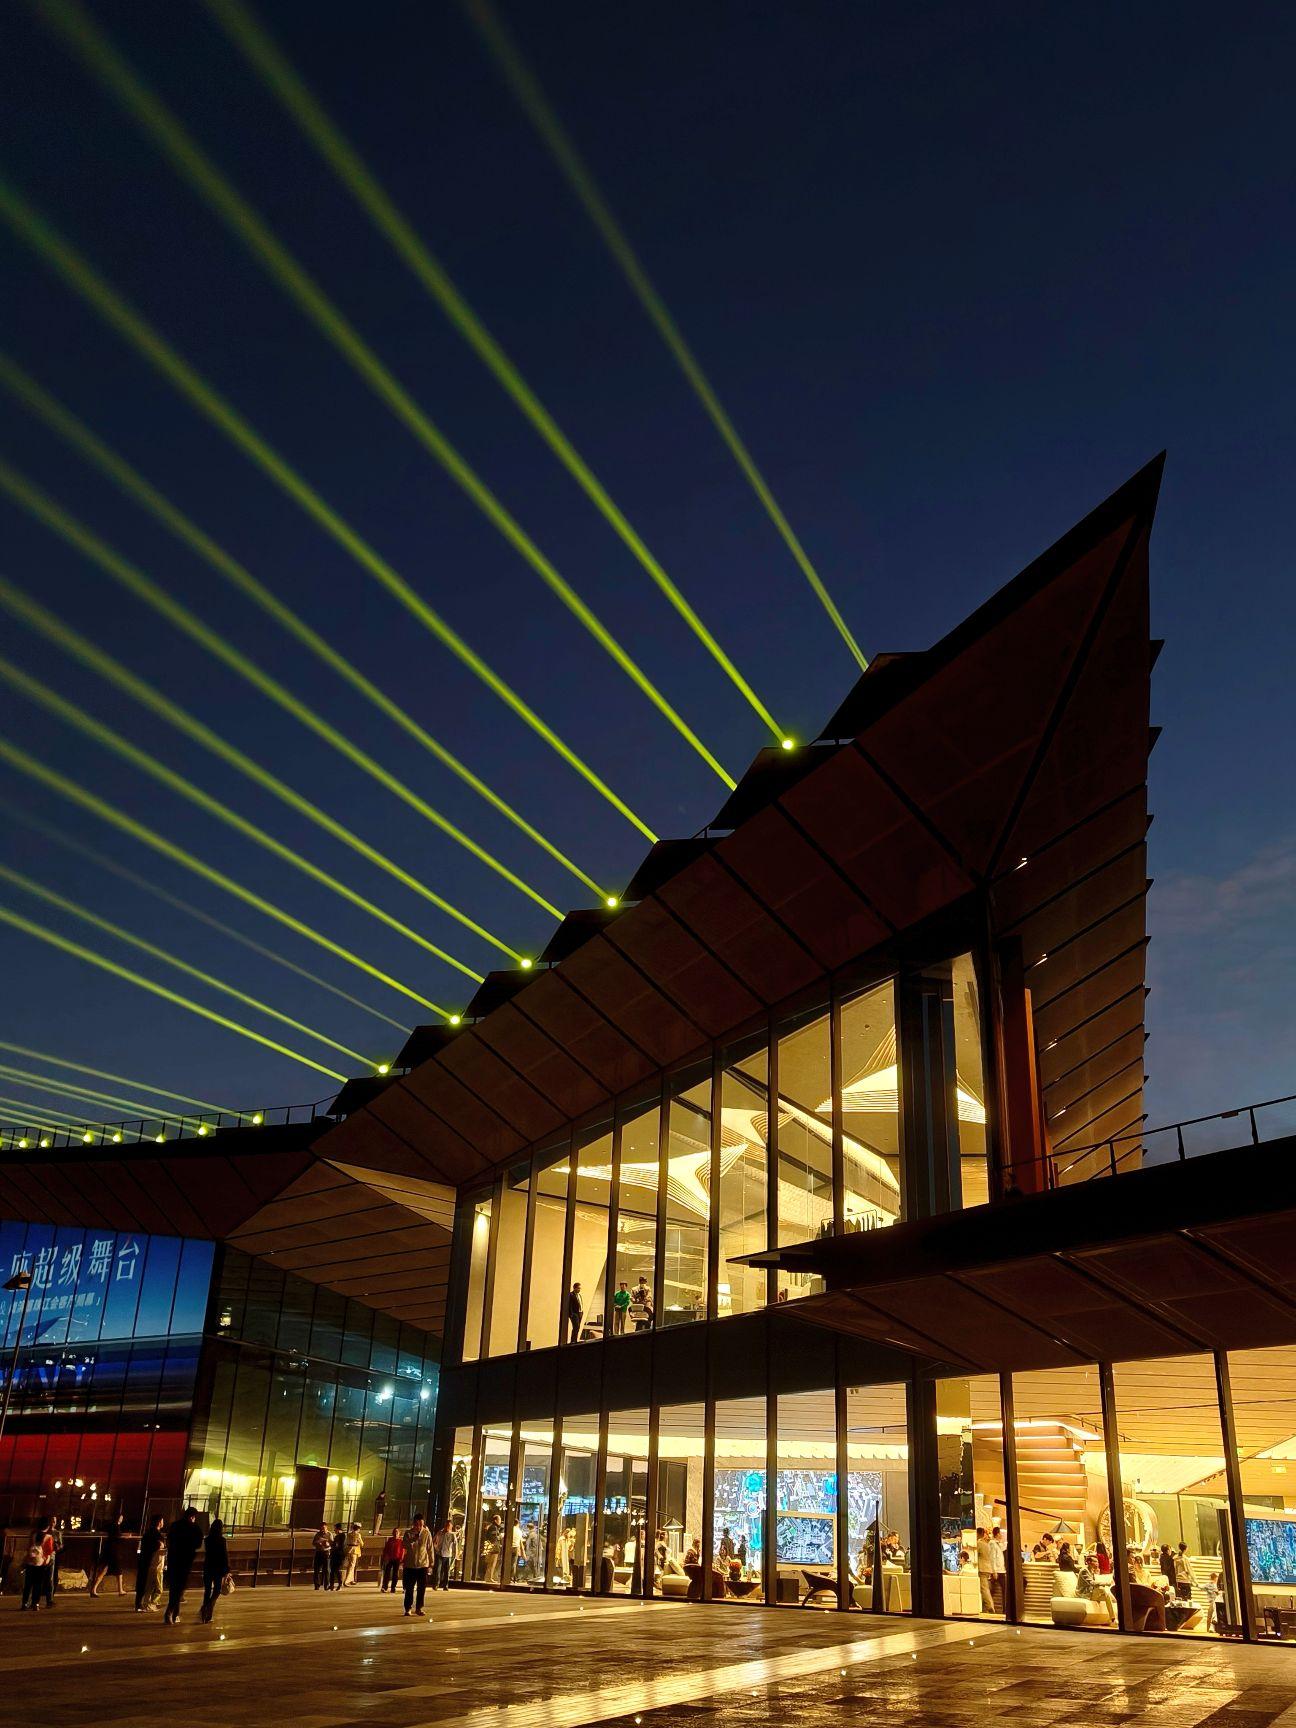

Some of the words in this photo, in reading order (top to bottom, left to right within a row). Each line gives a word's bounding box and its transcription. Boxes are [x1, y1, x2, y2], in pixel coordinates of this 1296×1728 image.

[0, 1238, 140, 1290] 座超级舞台
